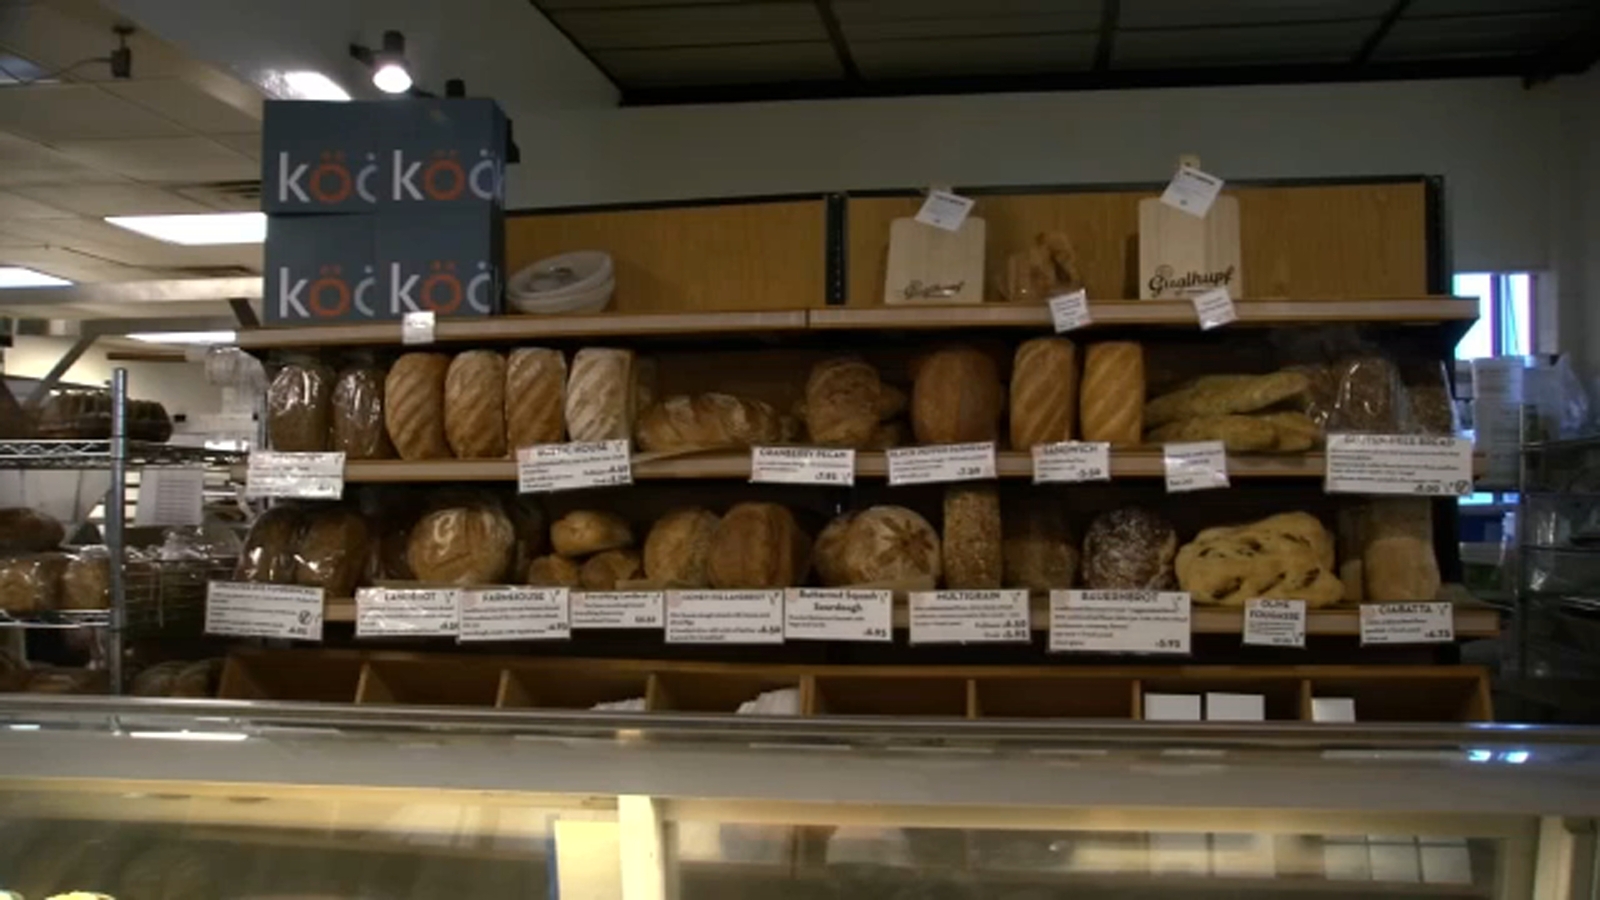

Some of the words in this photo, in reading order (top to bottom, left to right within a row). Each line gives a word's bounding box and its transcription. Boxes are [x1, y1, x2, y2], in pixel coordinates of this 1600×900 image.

[482, 592, 545, 601] FARMHOUSE
[800, 590, 843, 599] Butternut
[846, 590, 878, 601] Squash
[937, 592, 1001, 600] MULTIGRAIN
[814, 602, 863, 614] Sourdough
[1379, 604, 1433, 615] CIABATTA
